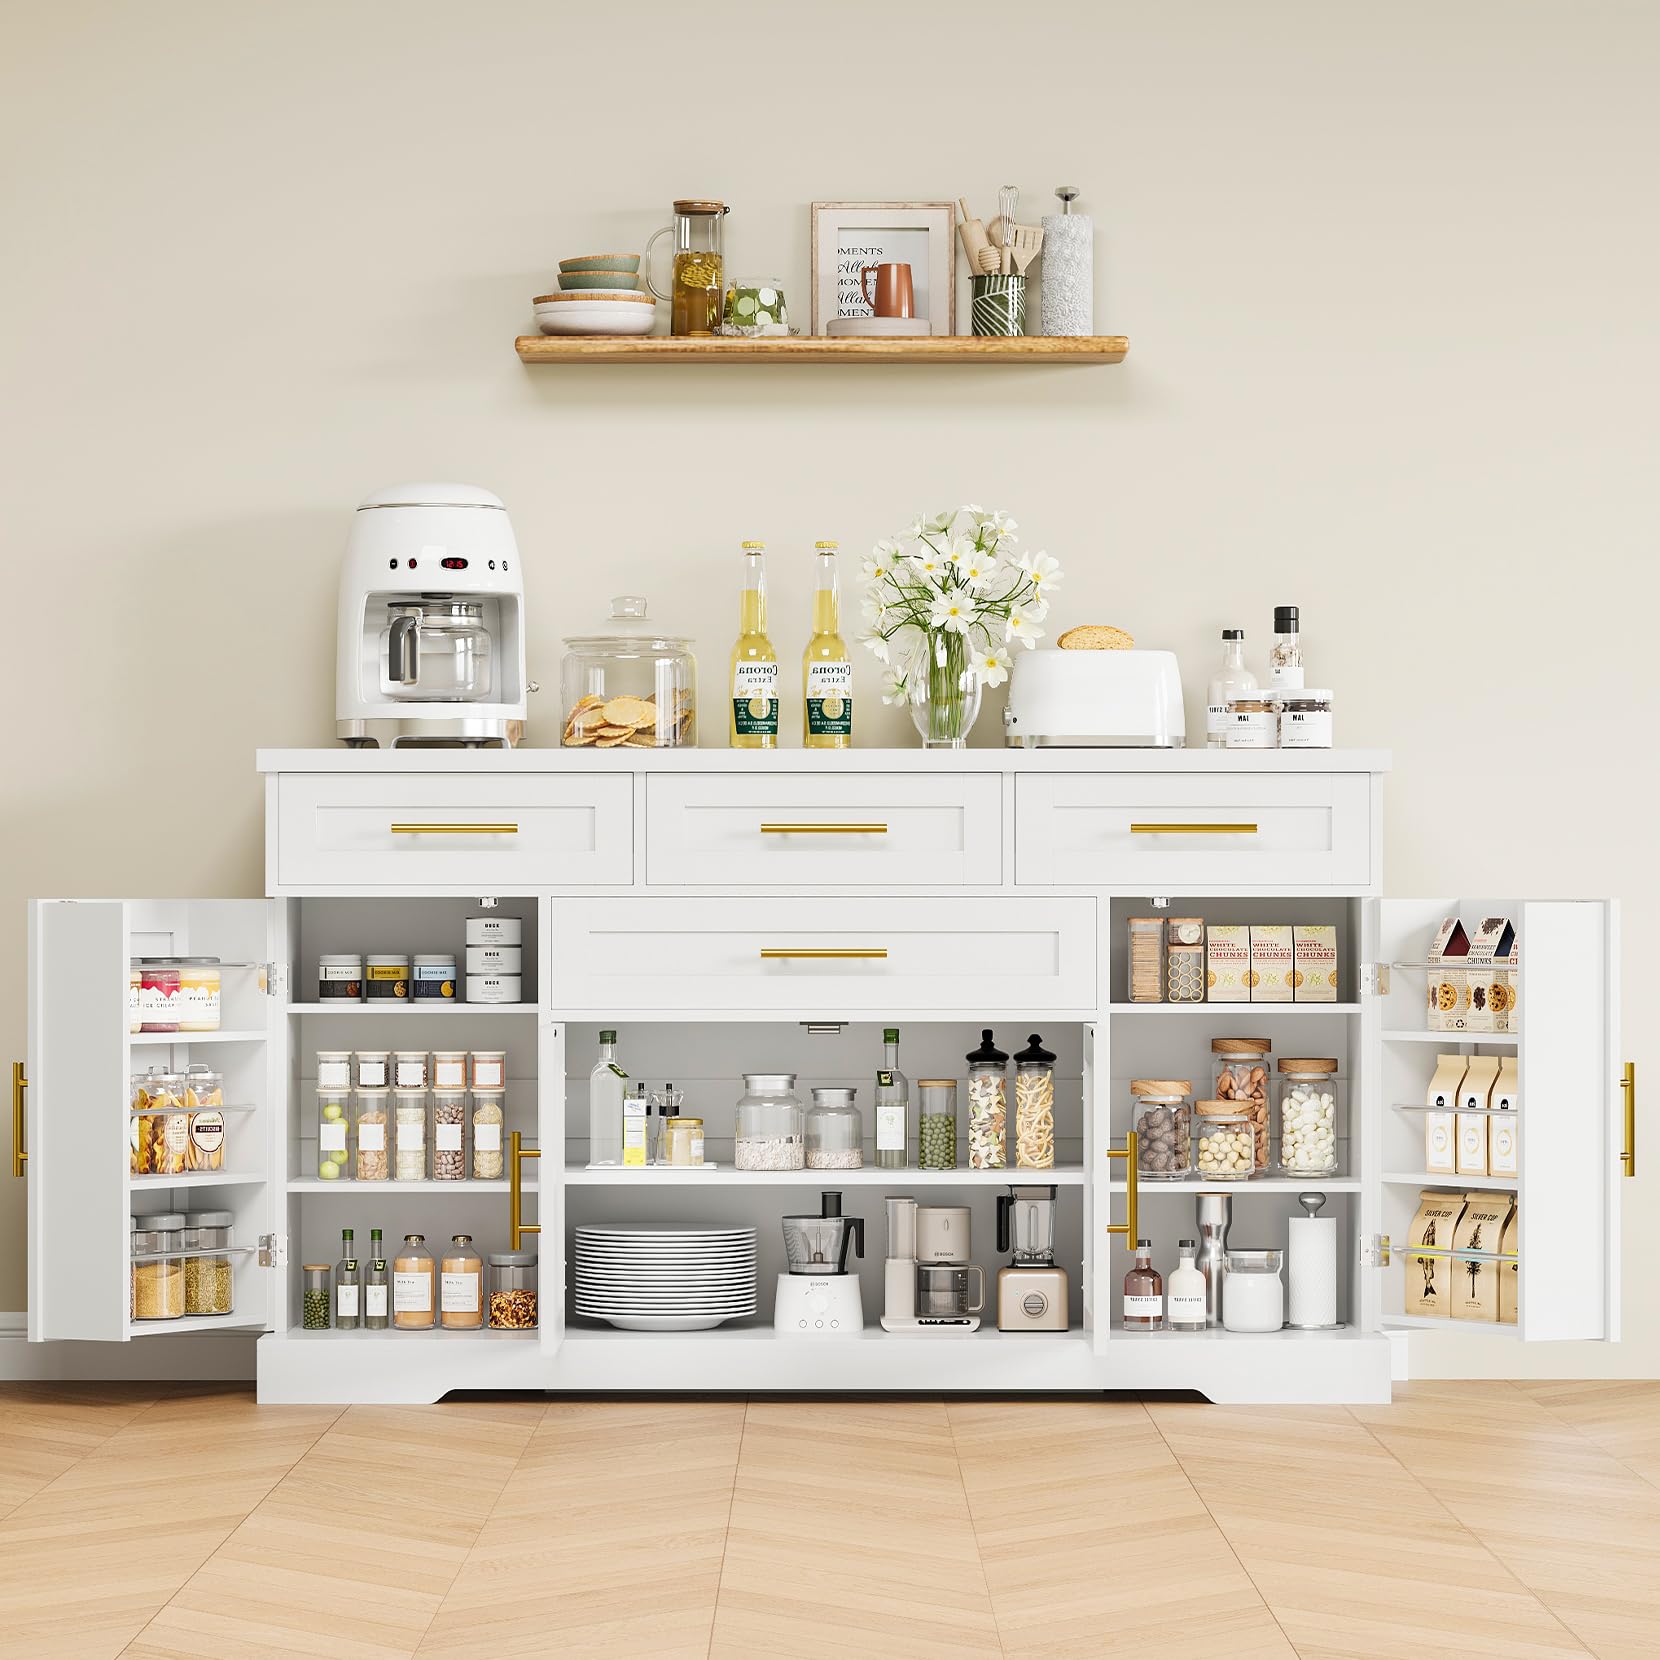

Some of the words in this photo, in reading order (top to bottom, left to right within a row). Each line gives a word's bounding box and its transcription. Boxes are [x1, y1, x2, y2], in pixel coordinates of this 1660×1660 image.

[837, 247, 883, 255] MENTS
[1467, 957, 1492, 965] CHUNKS
[1424, 1209, 1441, 1217] SILVER
[1441, 1210, 1453, 1218] CUP
